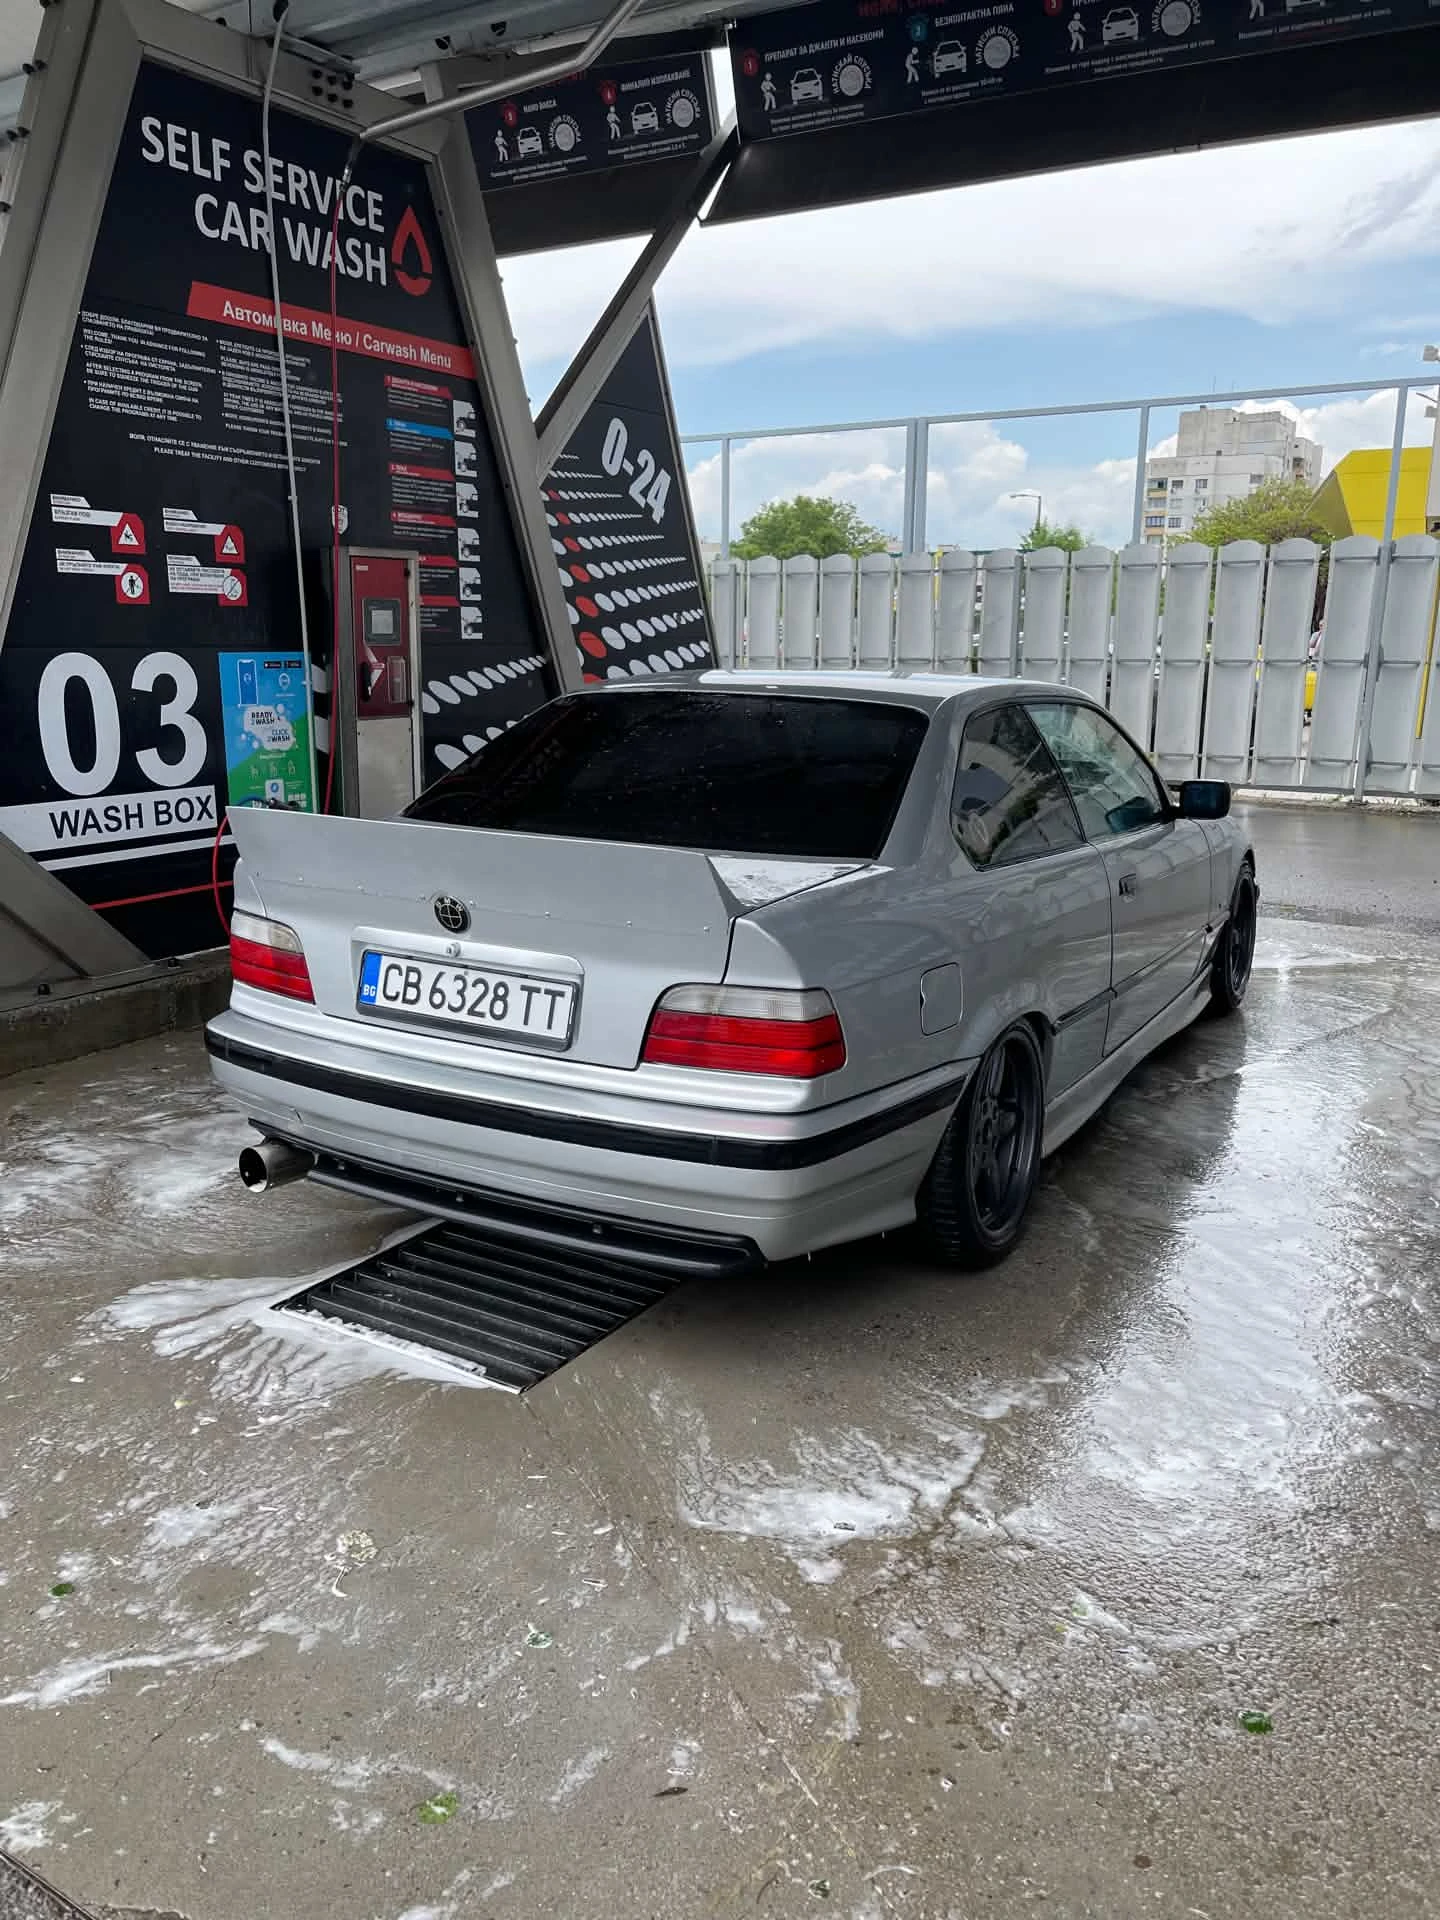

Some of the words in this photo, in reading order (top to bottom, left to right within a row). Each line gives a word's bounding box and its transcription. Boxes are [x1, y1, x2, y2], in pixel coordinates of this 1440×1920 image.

[764, 47, 797, 63] ПРЕПАРАТ
[798, 45, 808, 56] ЗА
[808, 39, 839, 55] ДЖАНТИ
[839, 37, 846, 47] И
[846, 28, 884, 45] НАСЕКОМИ
[141, 115, 231, 183] SELF
[242, 149, 385, 233] SERVICE
[194, 192, 273, 254] CAR
[282, 217, 388, 287] WASH
[355, 332, 361, 348] /
[362, 332, 417, 362] Carwash
[420, 347, 452, 369] Menu
[601, 417, 671, 525] 0-24
[38, 651, 207, 796] 03
[49, 802, 144, 840] WASH
[153, 794, 215, 828] BOX
[363, 984, 376, 997] BG
[382, 963, 422, 1006] CB
[429, 971, 510, 1021] 6328
[520, 984, 566, 1031] TT
